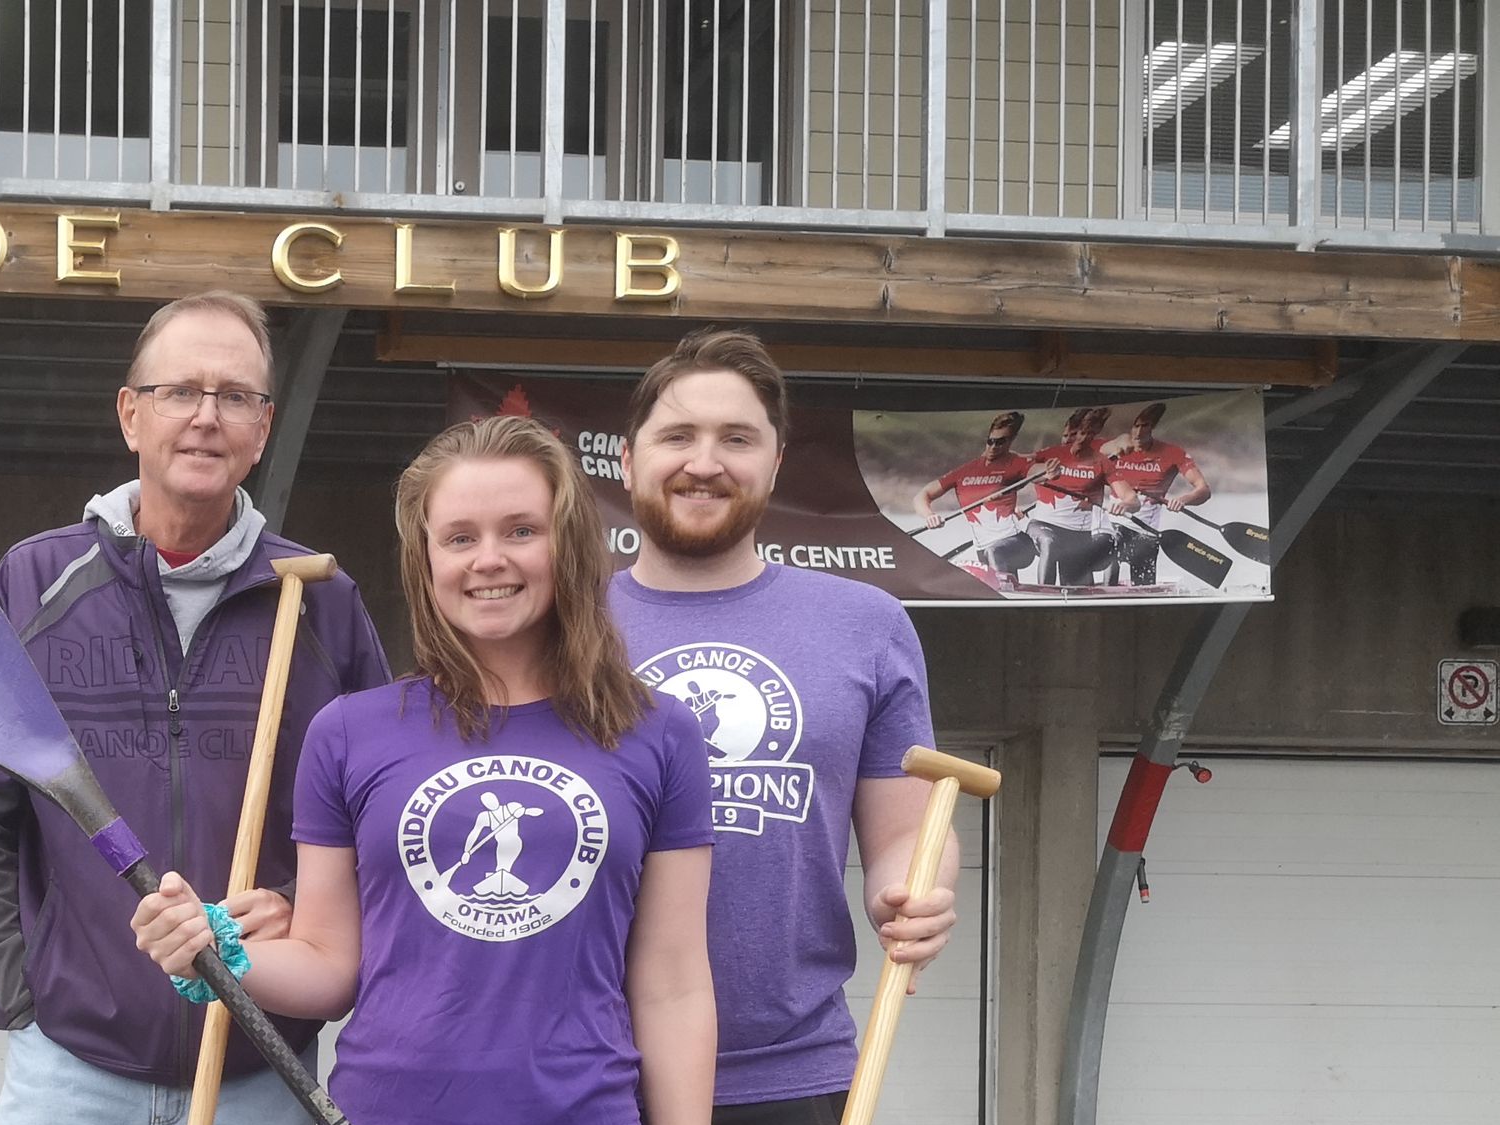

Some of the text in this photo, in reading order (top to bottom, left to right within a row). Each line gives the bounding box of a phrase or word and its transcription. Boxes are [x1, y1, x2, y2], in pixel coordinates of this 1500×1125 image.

[270, 222, 683, 300] CLUB
[962, 475, 1003, 486] CANADA
[1059, 465, 1095, 479] ANADA
[790, 545, 896, 569] CENTRE
[677, 650, 757, 676] CANOE
[760, 679, 791, 731] CLUB
[71, 728, 256, 760] ANOE CL
[710, 773, 801, 809] PIONS
[403, 759, 604, 867] RIDEAU CANOE CLUB
[711, 807, 738, 825] 19
[442, 911, 554, 938] Founded 1902
[457, 903, 542, 925] OTTAWA
